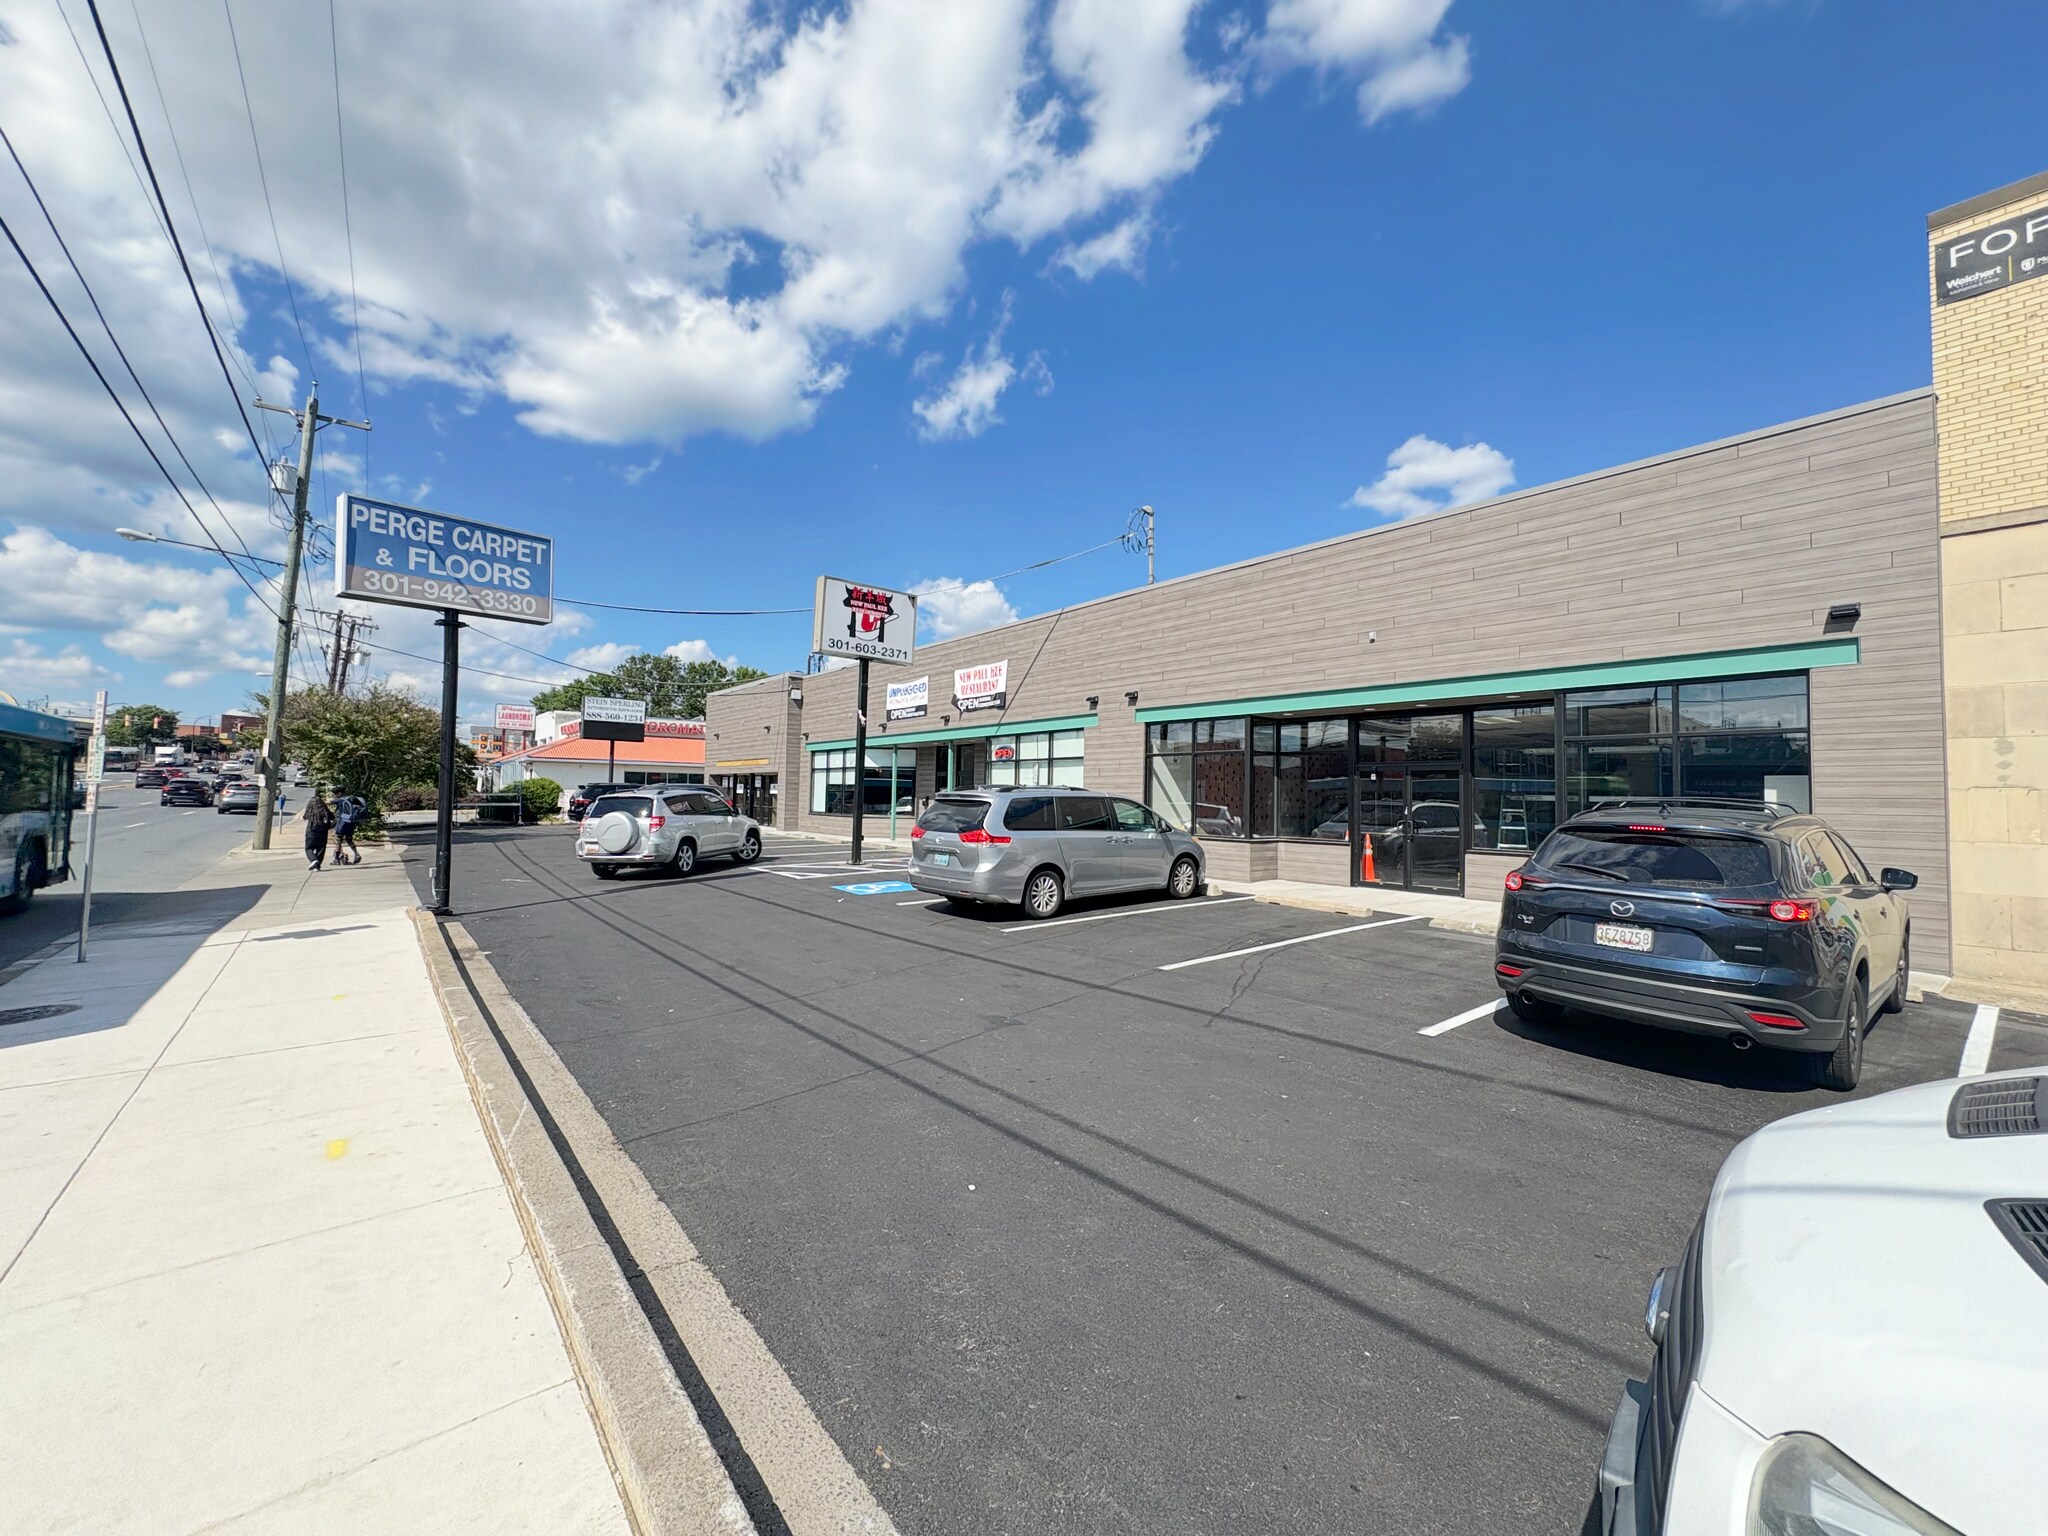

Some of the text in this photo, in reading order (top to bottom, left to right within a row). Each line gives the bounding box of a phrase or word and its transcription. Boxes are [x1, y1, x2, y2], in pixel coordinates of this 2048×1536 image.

[1946, 265, 2002, 289] Weichert
[351, 503, 547, 566] PERGE CARPET
[375, 546, 531, 590] & FLOORS
[364, 570, 537, 614] 301-942-3330
[851, 599, 863, 607] NEW
[863, 602, 877, 610] PAUL
[828, 638, 908, 660] 301-603-2371
[959, 671, 972, 683] NEW
[973, 667, 988, 681] PAUL
[889, 682, 928, 698] UNPLUGGED
[960, 679, 999, 696] RESTAURANT
[586, 697, 644, 709] STEIN SPERLING
[957, 698, 979, 710] OPEN
[498, 711, 534, 721] LAUNDROMAT
[586, 711, 643, 722] 888-560-1234
[890, 709, 906, 720] OPEN
[995, 748, 1013, 759] OPEN
[1597, 927, 1650, 946] 3EZ8758
